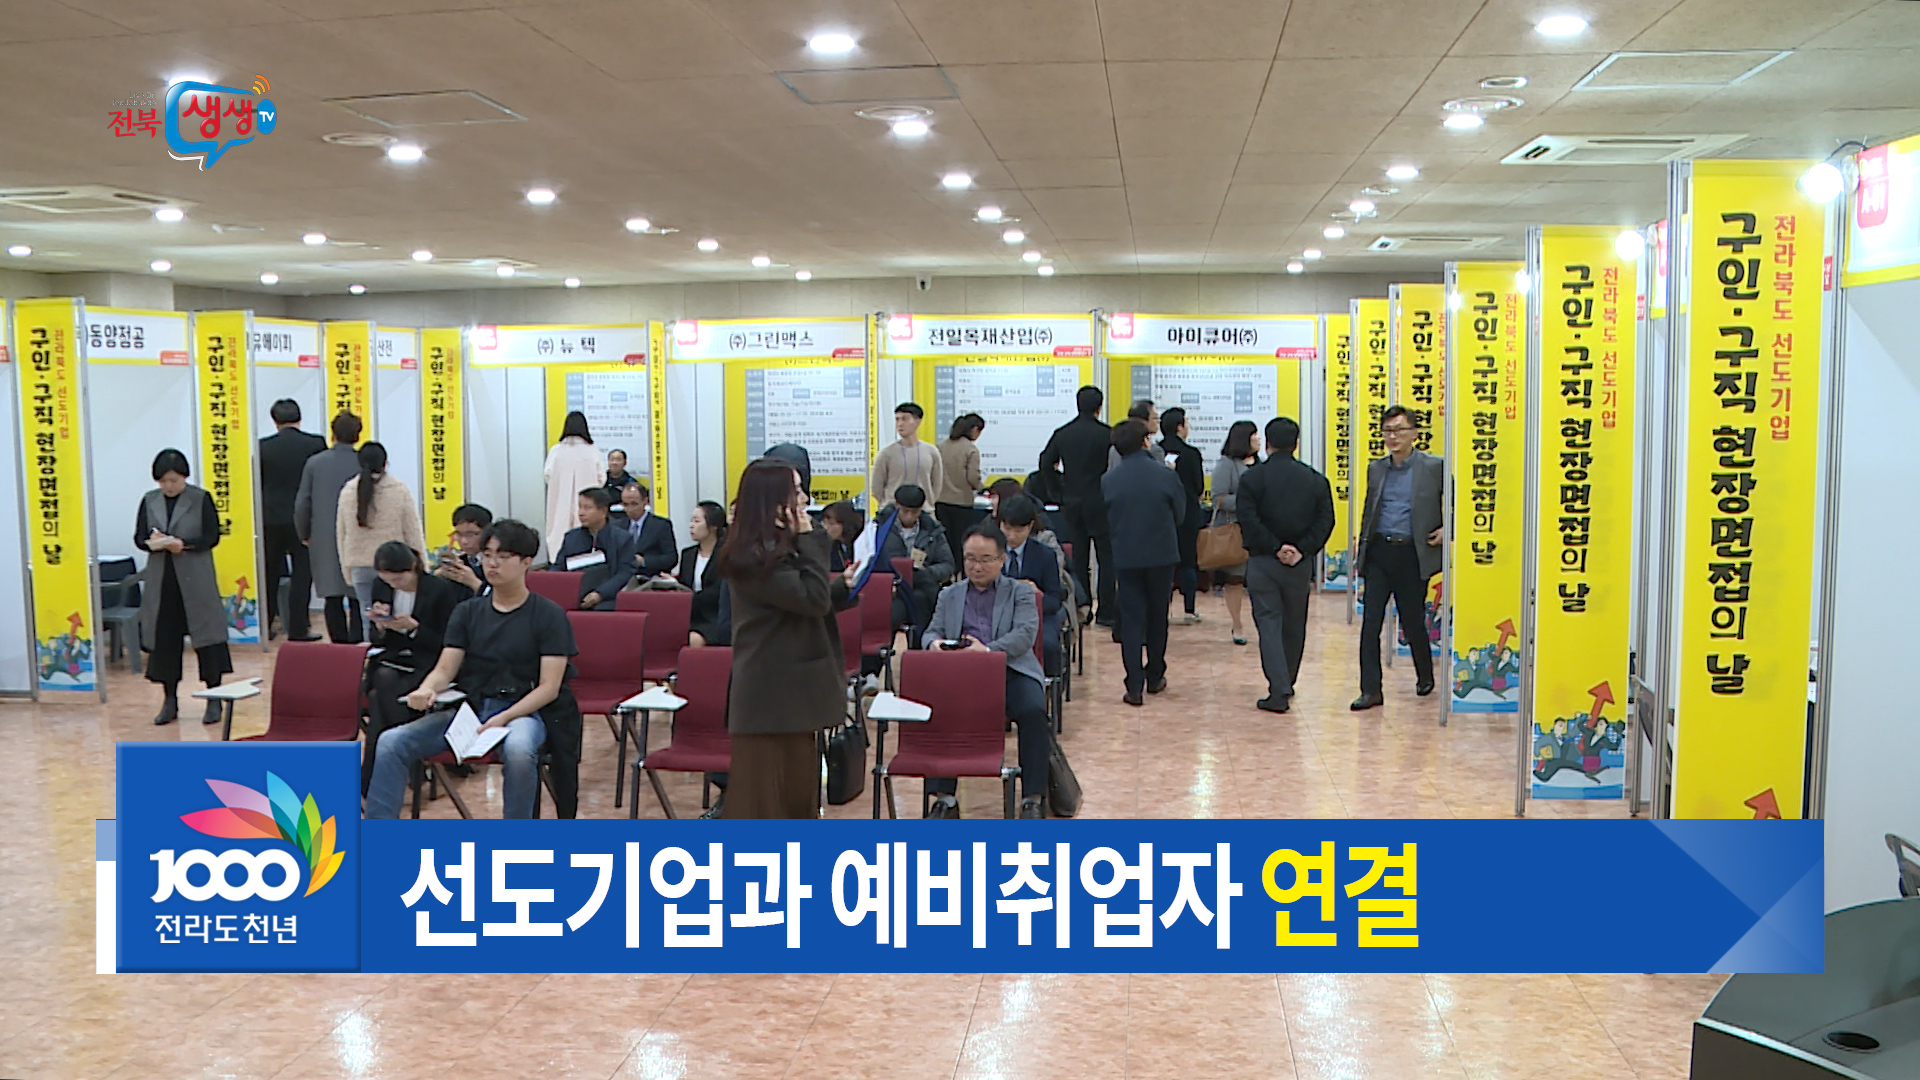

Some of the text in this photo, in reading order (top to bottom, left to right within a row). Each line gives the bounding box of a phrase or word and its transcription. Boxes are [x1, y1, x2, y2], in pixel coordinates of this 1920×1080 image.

[1412, 309, 1433, 404] 구인·구직
[1471, 290, 1498, 565] 구인·구직 현장면접의 날
[1558, 264, 1594, 613] 구인·구직 현장면접의 날
[1601, 267, 1619, 430] 전라북도 선도기업
[1769, 214, 1797, 440] 전라북도 선도기업
[36, 433, 60, 537] 현장면접의
[1706, 211, 1762, 694] 구인·구직 현장면접의 날
